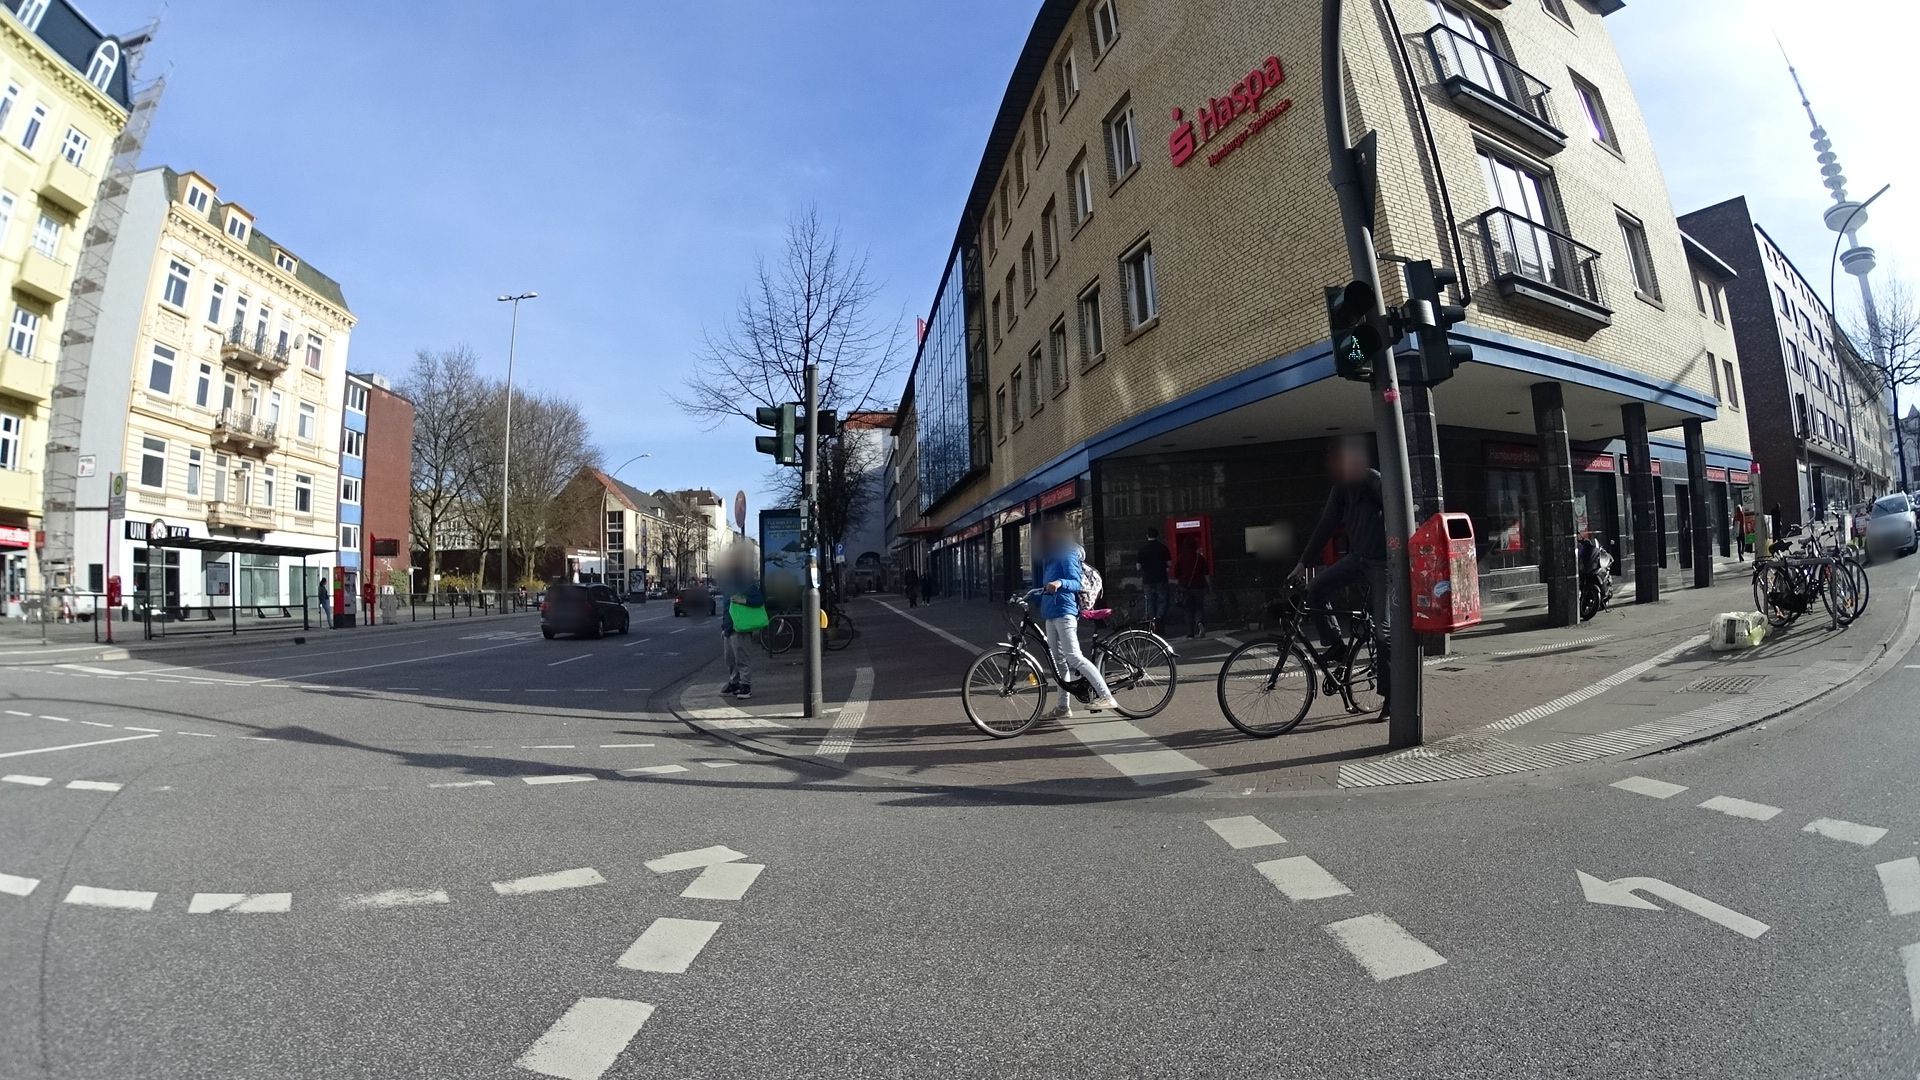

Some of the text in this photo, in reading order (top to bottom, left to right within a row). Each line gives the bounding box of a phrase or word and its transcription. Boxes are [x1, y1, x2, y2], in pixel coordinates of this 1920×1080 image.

[1198, 55, 1284, 142] Haspa
[1208, 98, 1292, 167] Hamburger Sparkasse
[130, 522, 187, 539] UNI KAT
[837, 544, 843, 554] P
